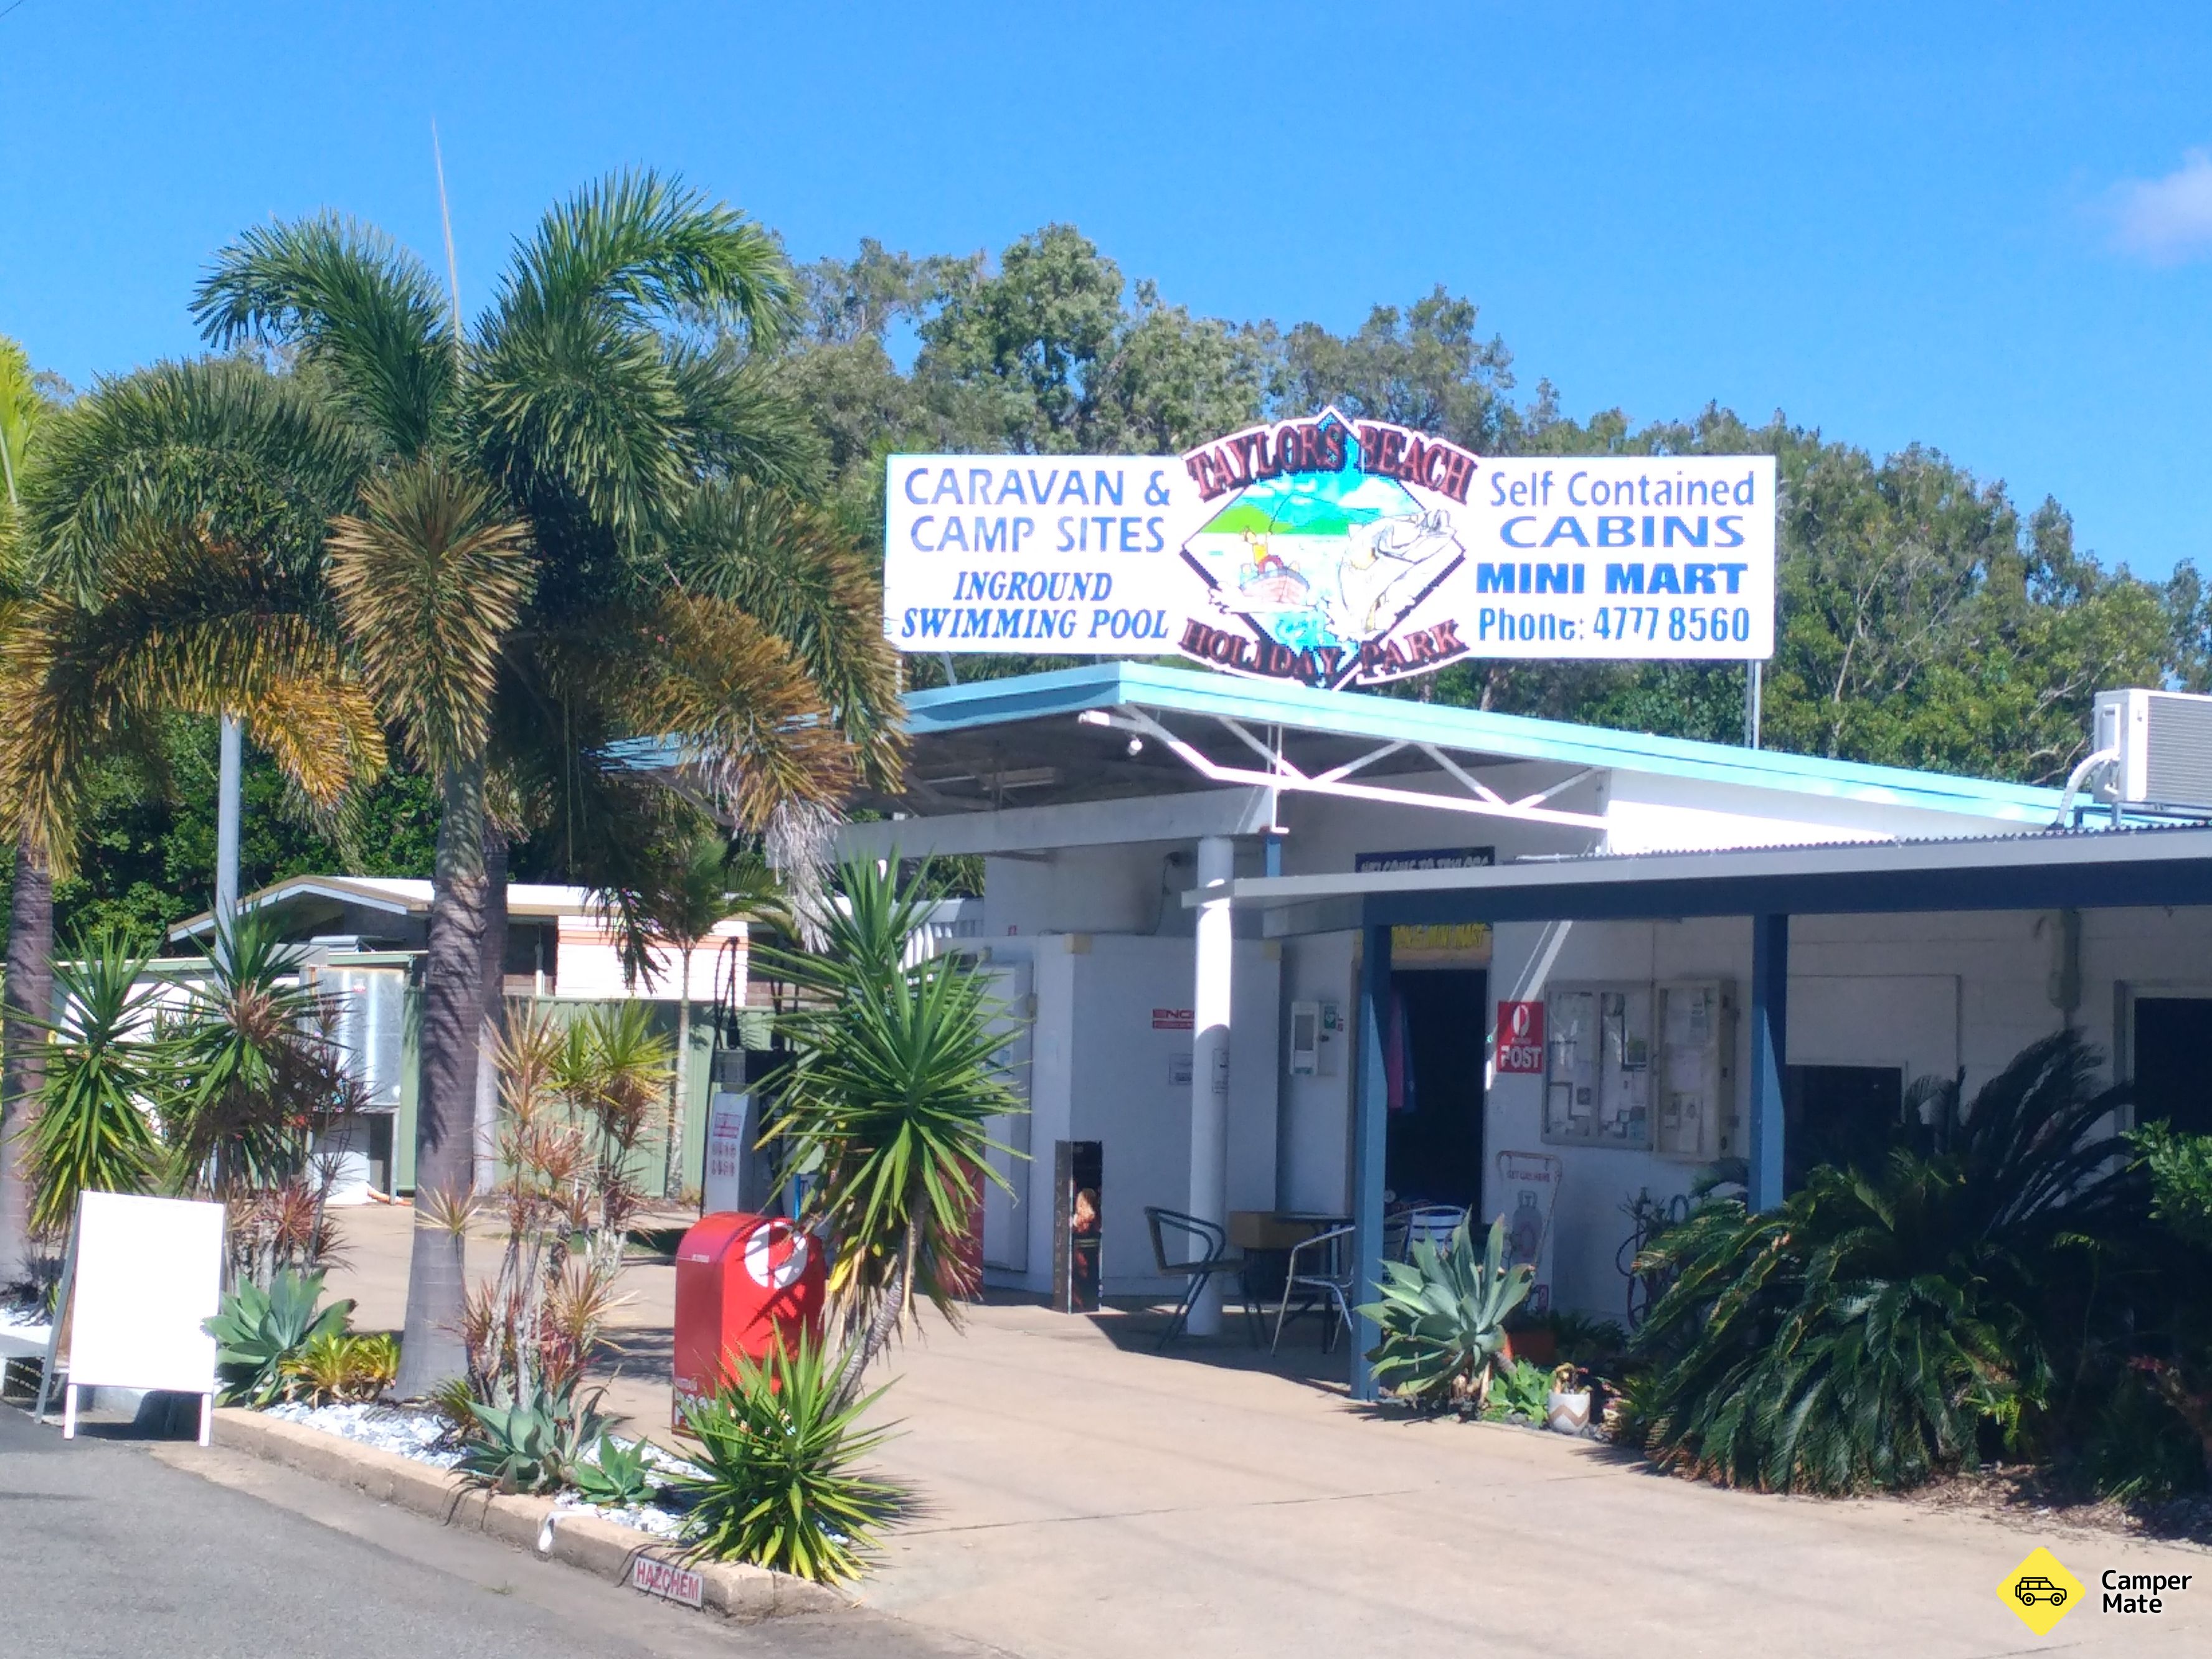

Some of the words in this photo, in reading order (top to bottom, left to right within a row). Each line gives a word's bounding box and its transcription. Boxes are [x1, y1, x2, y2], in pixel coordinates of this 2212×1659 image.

[1186, 424, 1346, 503] TAYLORS
[1358, 425, 1478, 505] BEACH
[905, 468, 1124, 506] CARAVAN
[1145, 470, 1170, 506] &
[1491, 471, 1554, 506] Self
[1567, 471, 1754, 506] Contained
[910, 515, 1034, 552] CAMP
[1057, 516, 1164, 552] SITES
[1500, 516, 1745, 547] CABINS
[953, 571, 1113, 602] INGROUND
[1476, 562, 1585, 593] MINI
[1605, 562, 1749, 594] MART
[901, 608, 1077, 638] SWIMMING
[1088, 608, 1168, 639] POOL
[1480, 607, 1585, 641] Phone:
[1594, 606, 1660, 640] 4777
[1668, 607, 1750, 641] 8560
[1179, 618, 1344, 678] HOLIDAY
[1358, 619, 1469, 678] PARK
[1501, 1045, 1542, 1069] POST
[637, 1560, 699, 1600] HAZCHEM
